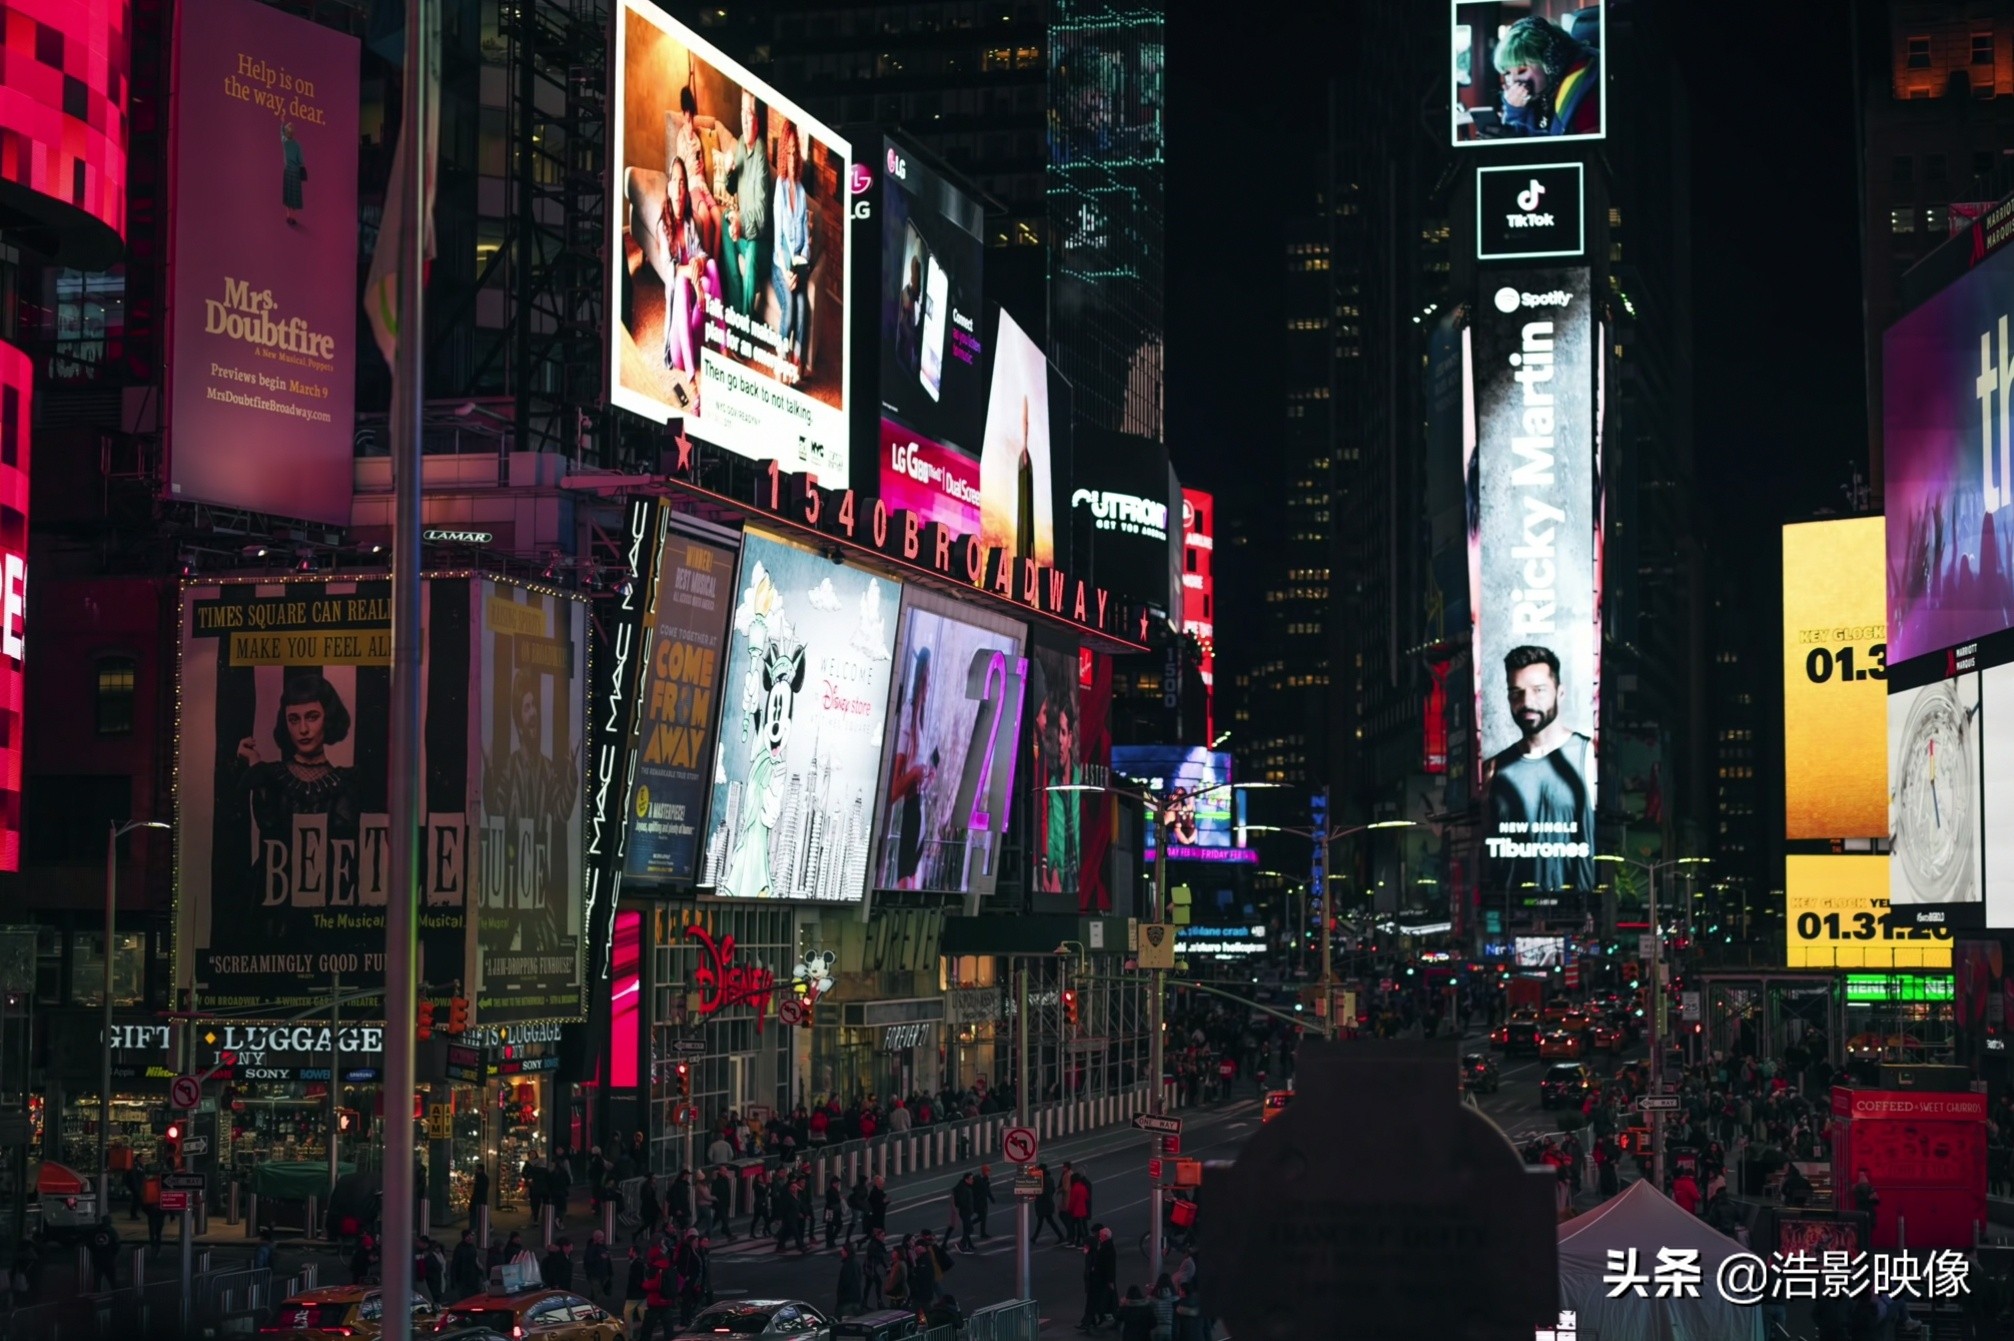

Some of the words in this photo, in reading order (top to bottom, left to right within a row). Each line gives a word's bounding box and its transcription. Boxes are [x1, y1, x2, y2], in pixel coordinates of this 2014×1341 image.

[238, 53, 276, 88] Help
[279, 67, 292, 90] is
[295, 79, 315, 97] on
[224, 76, 249, 101] the
[253, 89, 286, 117] way,
[289, 97, 326, 126] dear.
[895, 155, 906, 180] LG
[851, 200, 871, 220] G
[1506, 212, 1555, 228] TikTok
[223, 276, 278, 314] Mrs.
[1521, 290, 1574, 309] Spotify
[205, 299, 335, 360] Doubtfire
[211, 362, 257, 384] Previews
[258, 372, 287, 392] begin
[289, 380, 321, 398] March
[322, 387, 329, 398] 9
[206, 386, 332, 423] MrsDoubtfireBroadway.com
[704, 358, 725, 384] Then
[727, 372, 738, 392] go
[740, 373, 760, 400] back
[761, 386, 770, 404] to
[771, 393, 785, 410] not
[786, 399, 813, 427] talking.
[1509, 321, 1555, 486] Martin
[892, 443, 906, 474] LG
[428, 530, 486, 543] LAMAR
[767, 458, 887, 548] 1540
[903, 510, 1109, 629] BROADWAY
[1511, 496, 1566, 635] Ricky
[197, 604, 243, 629] TIMES
[247, 602, 306, 629] SQUARE
[311, 600, 342, 624] CAN
[1799, 627, 1830, 644] KEY
[1831, 625, 1886, 642] GLOCK
[236, 636, 281, 659] MAKE
[287, 636, 317, 659] YOU
[323, 636, 362, 658] FEEL
[656, 638, 716, 689] COME
[1956, 656, 1977, 671] MARQUIS
[642, 723, 706, 770] AWAY
[1499, 822, 1529, 833] NEW
[1531, 822, 1578, 833] SINGLE
[1201, 849, 1229, 860] FRIDAY
[1485, 837, 1590, 858] Tiburones
[262, 825, 459, 908] BEETE
[313, 912, 335, 928] The
[208, 954, 313, 974] “SCREAMINGLY
[319, 953, 358, 973] GOOD
[1685, 1002, 1698, 1013] 25
[222, 1027, 383, 1053] LUGGAGE
[507, 1022, 562, 1045] LUGGAGE
[883, 1025, 917, 1049] FOREVER
[238, 1051, 266, 1065] NY
[244, 1068, 290, 1080] SONY
[1856, 1099, 1914, 1113] COFFEED
[1919, 1101, 1944, 1114] SWEET
[1946, 1102, 1982, 1114] CHURROS
[431, 1105, 441, 1133] ATM
[1159, 1119, 1176, 1130] WAY
